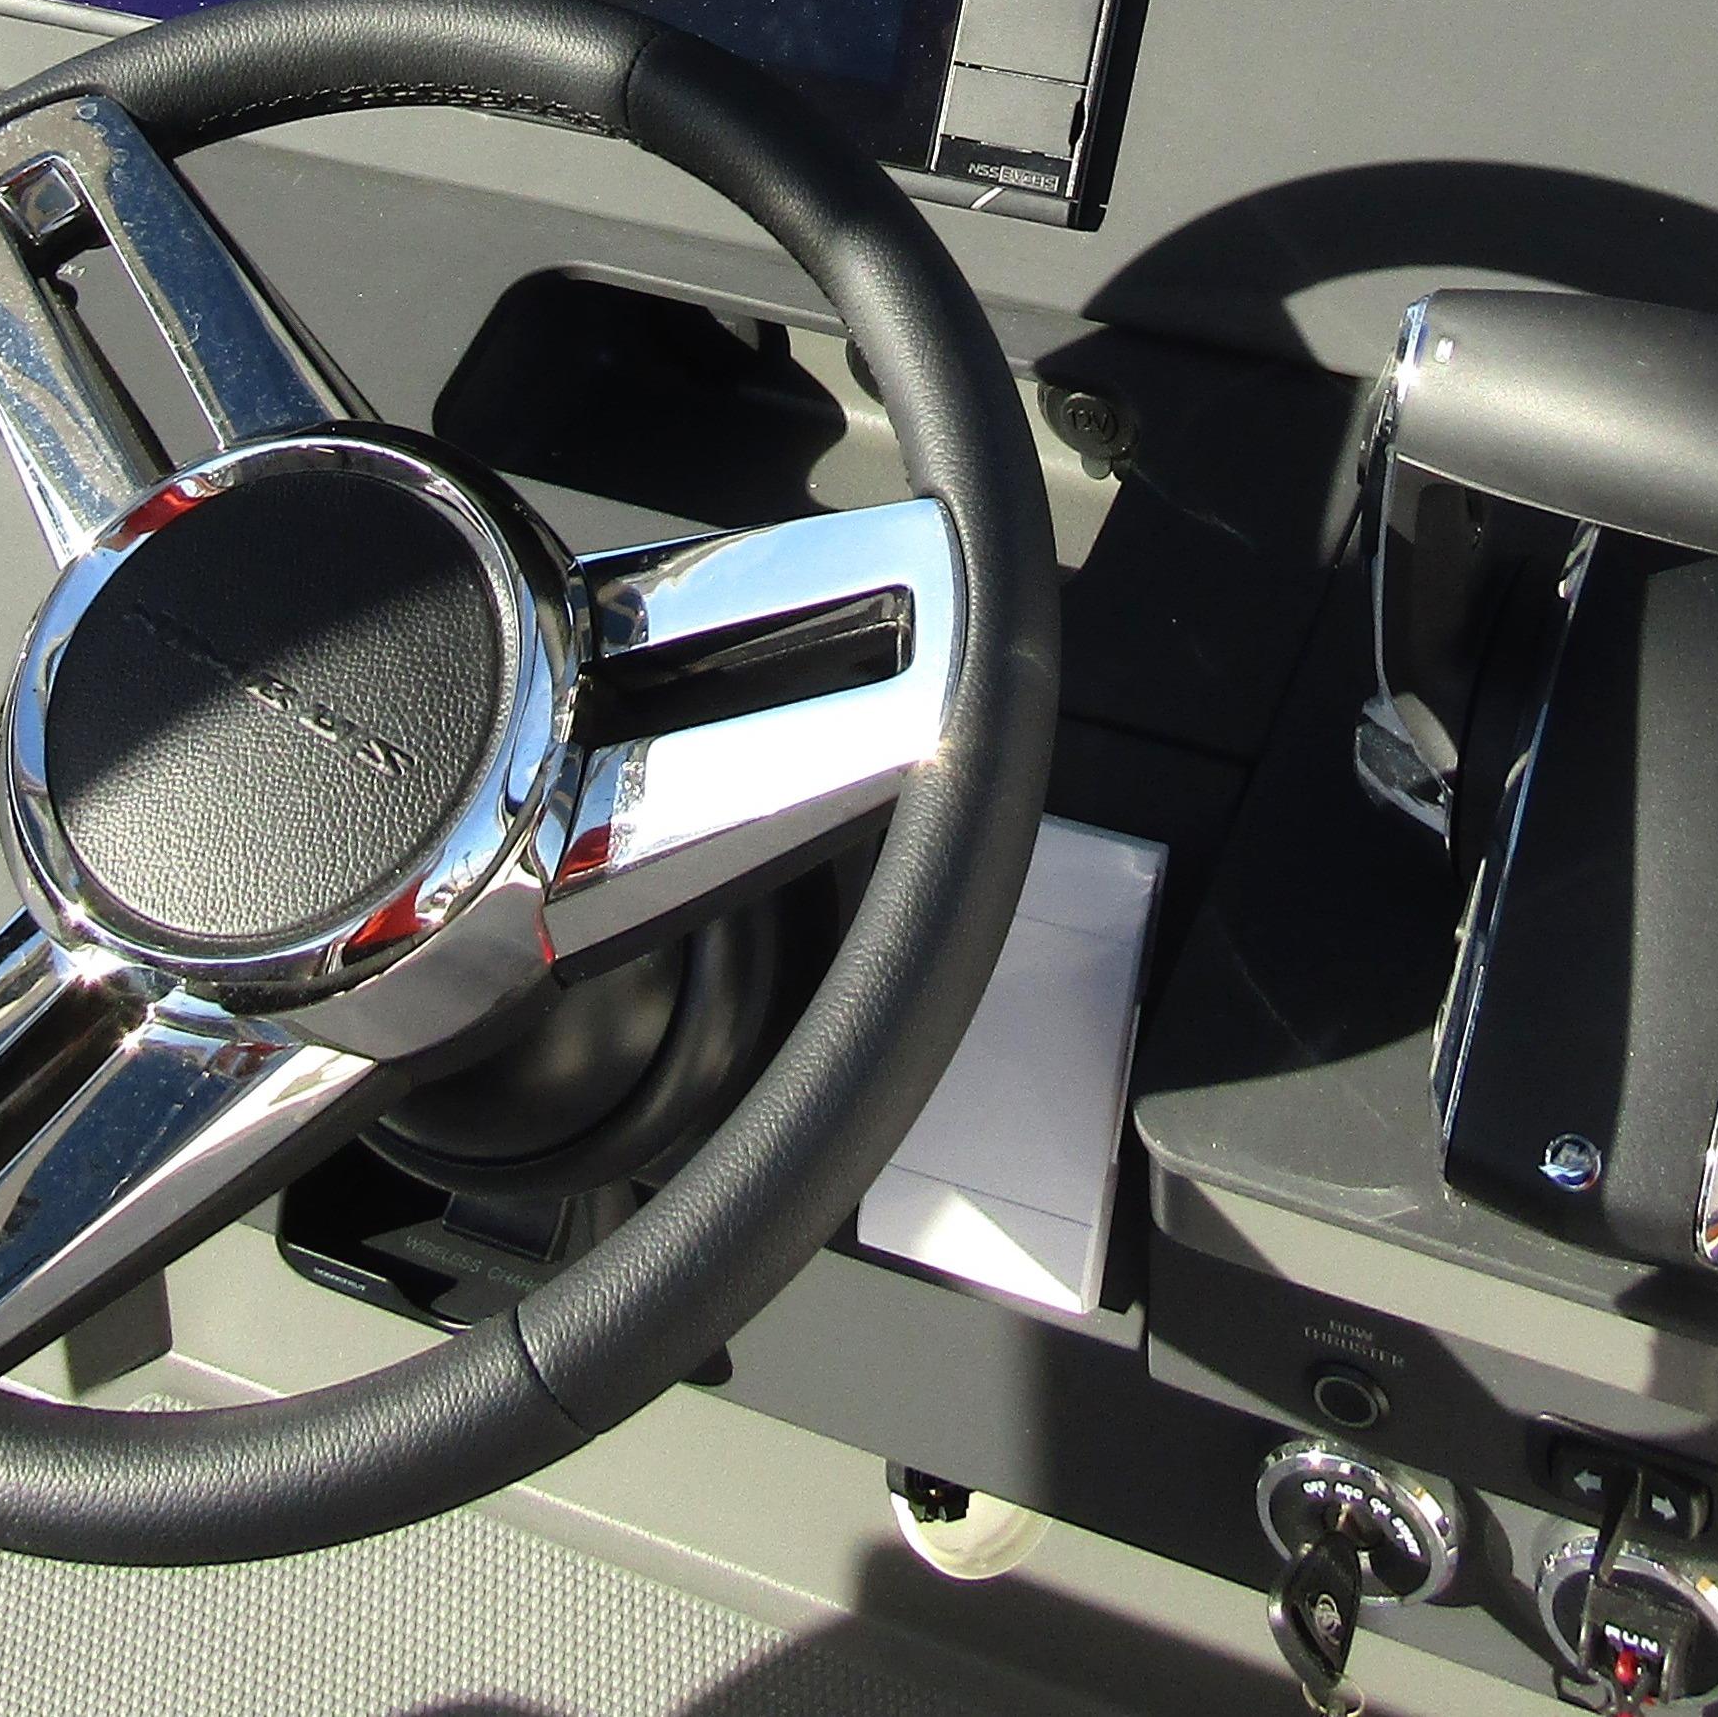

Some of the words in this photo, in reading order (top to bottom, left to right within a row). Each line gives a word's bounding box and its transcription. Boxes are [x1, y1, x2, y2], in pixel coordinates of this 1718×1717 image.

[968, 160, 1000, 181] NSS
[1303, 1325, 1405, 1371] THRUSTER
[1604, 1622, 1660, 1656] RUN
